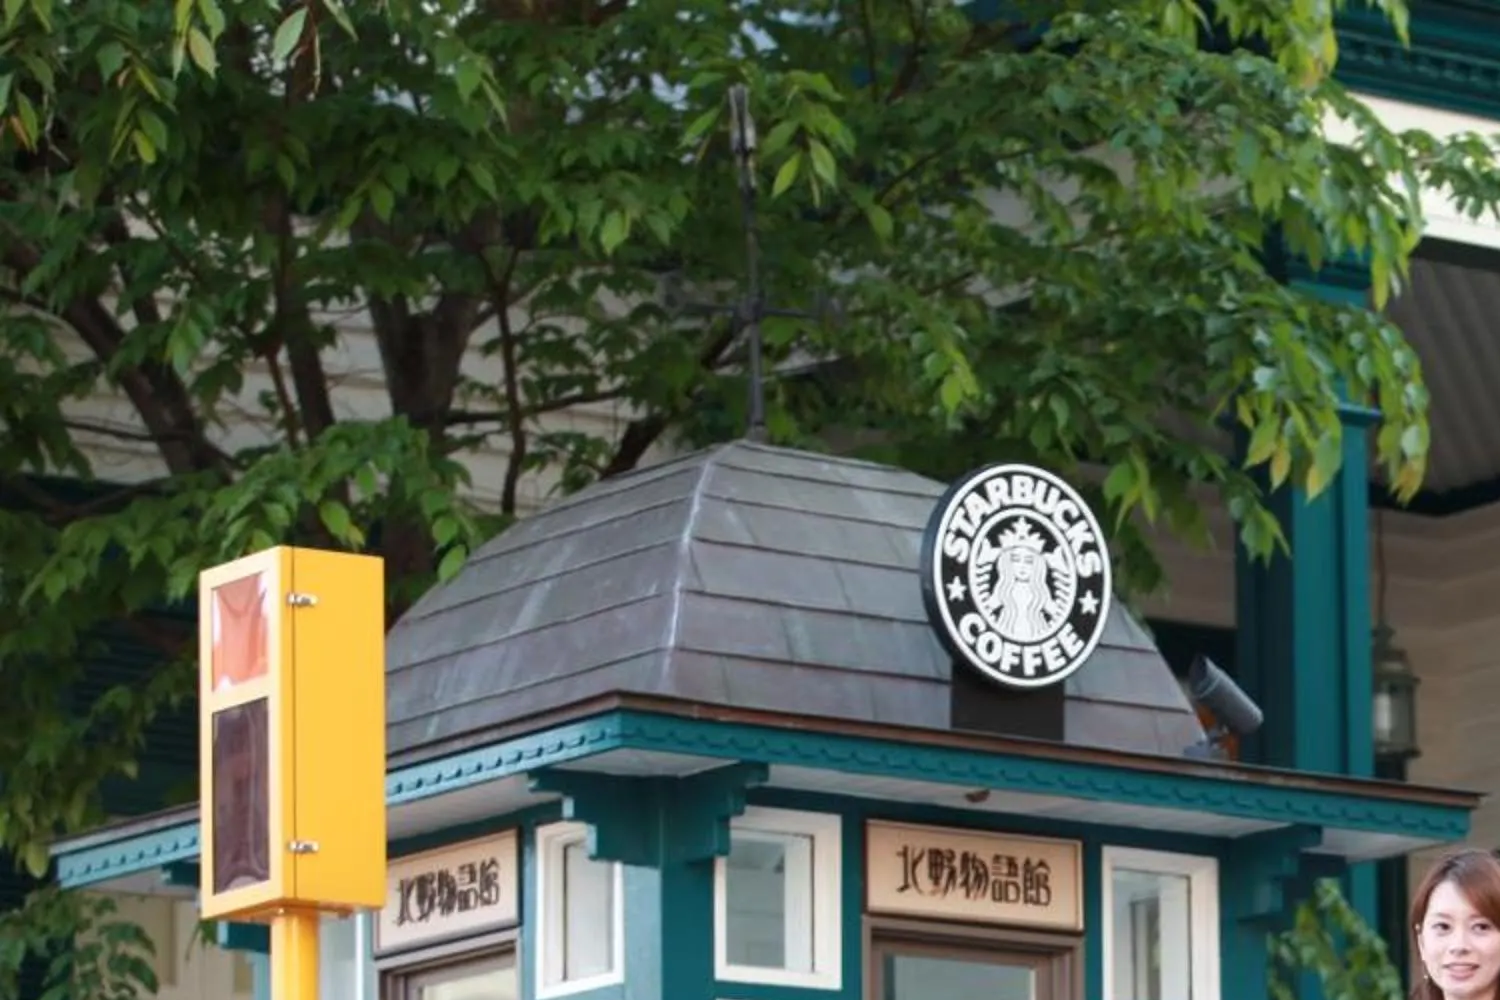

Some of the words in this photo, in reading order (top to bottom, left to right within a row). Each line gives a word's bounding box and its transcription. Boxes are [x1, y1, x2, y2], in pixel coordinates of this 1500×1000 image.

[943, 474, 1101, 578] STARBUCKS
[959, 612, 1085, 677] COFFEE
[896, 844, 1052, 907] 北野物語館
